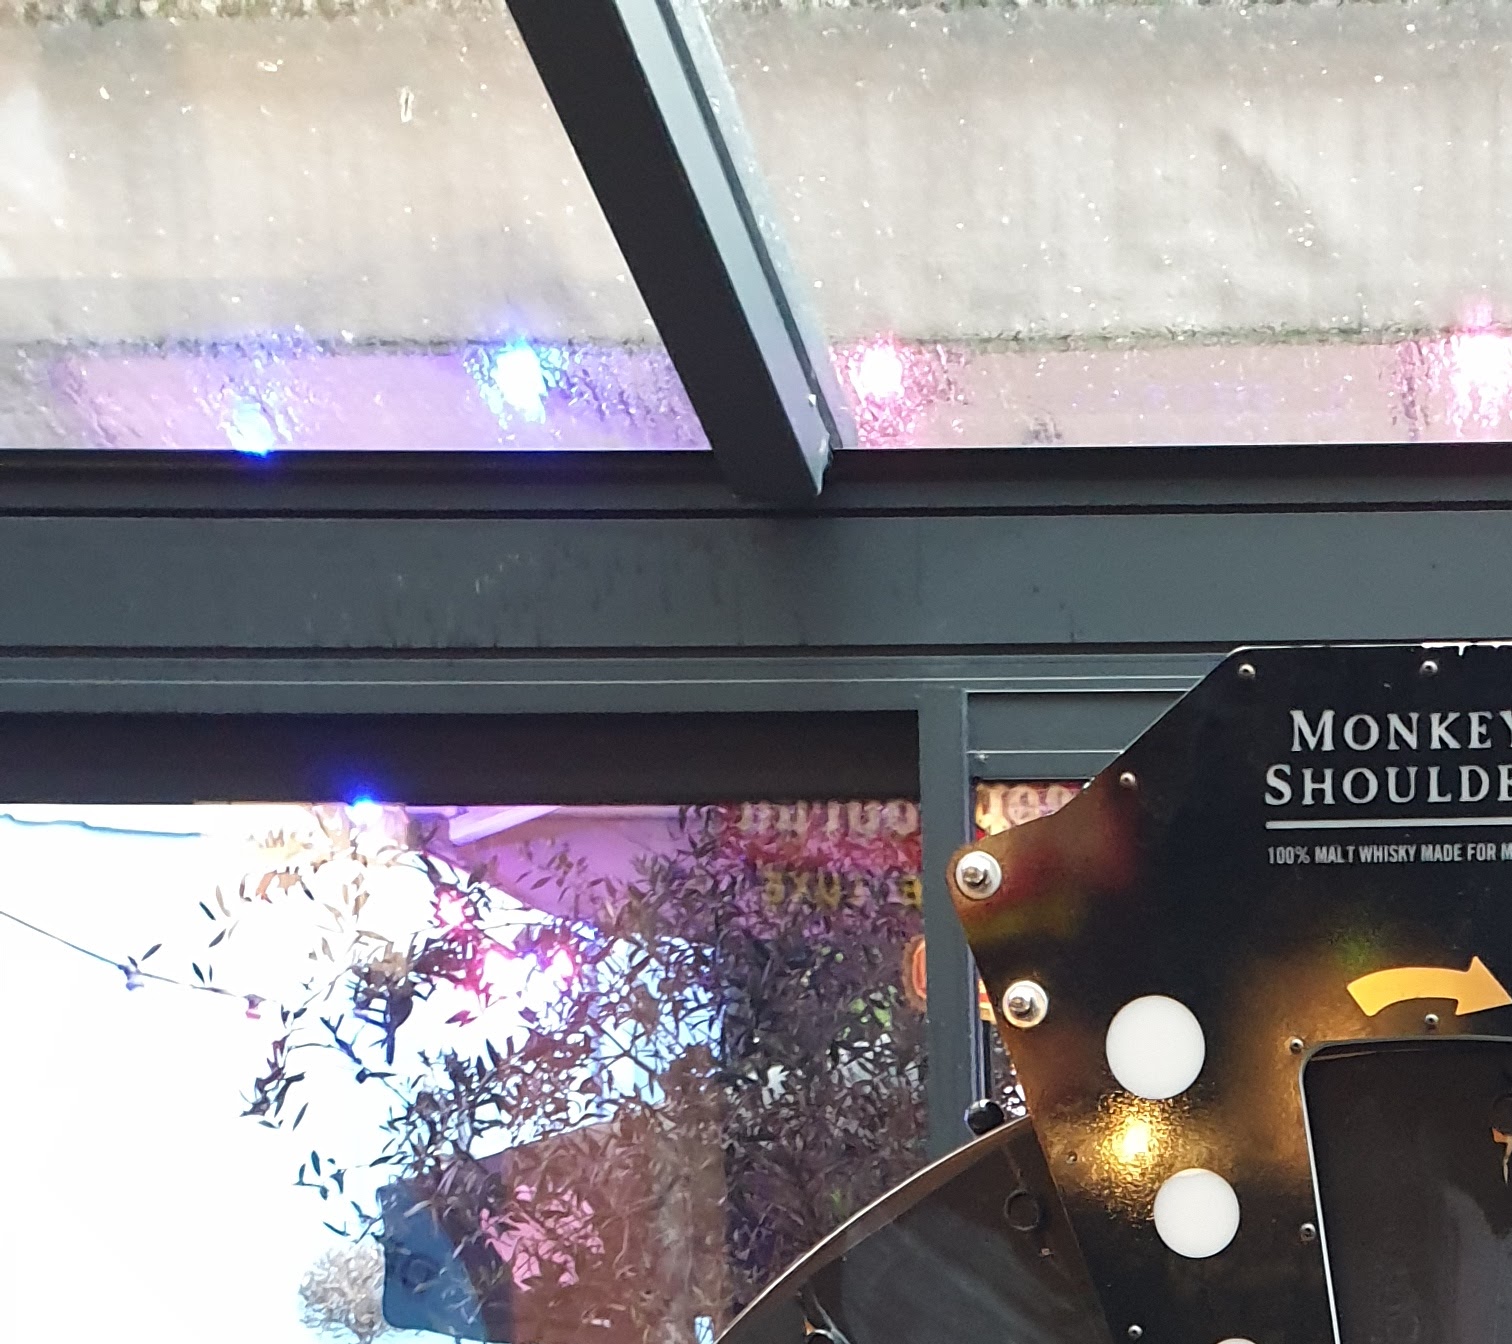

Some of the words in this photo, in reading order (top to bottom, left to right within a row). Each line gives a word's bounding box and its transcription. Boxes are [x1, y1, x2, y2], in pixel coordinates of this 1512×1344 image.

[1267, 846, 1310, 865] 100%
[1314, 845, 1355, 864] MALT
[1358, 844, 1417, 863] WHISKY
[1420, 843, 1463, 862] MADE
[1467, 842, 1497, 862] FOR
